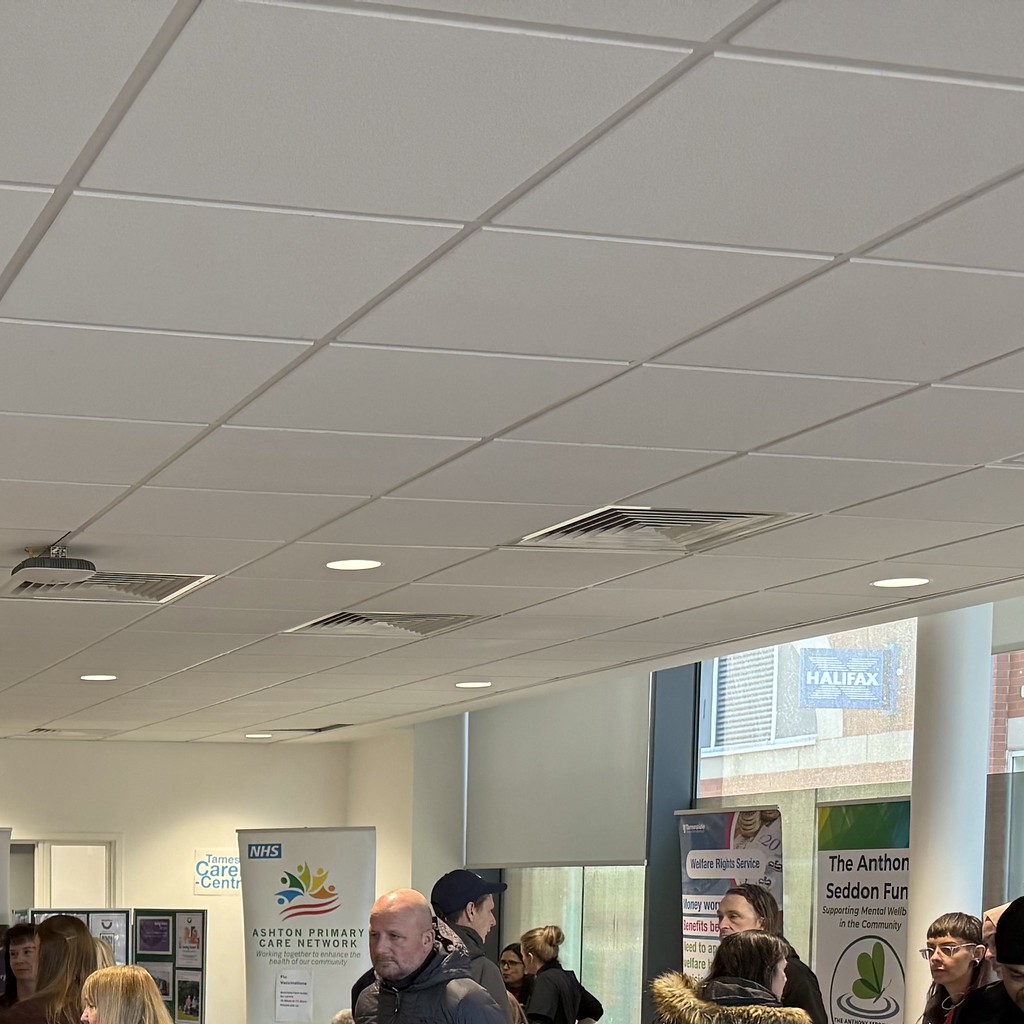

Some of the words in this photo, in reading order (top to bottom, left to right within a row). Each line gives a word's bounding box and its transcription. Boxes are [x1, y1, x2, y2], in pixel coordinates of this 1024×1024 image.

[806, 671, 879, 686] HALIFAX
[249, 844, 280, 858] NHS
[195, 860, 238, 877] Care
[690, 858, 714, 870] Welfare
[716, 858, 735, 871] Rights
[736, 857, 760, 869] Service
[829, 855, 853, 872] The
[857, 853, 909, 872] Anthon
[826, 882, 879, 899] Seddon
[883, 882, 908, 900] Fun
[822, 905, 859, 916] Supporting
[861, 906, 886, 916] Mental
[839, 919, 846, 928] in
[847, 919, 860, 929] the
[862, 920, 902, 931] Community
[252, 928, 302, 937] ASHTON
[308, 929, 365, 937] PRIMARY
[259, 939, 291, 948] CARE
[297, 939, 357, 948] NETWORK
[698, 942, 706, 954] to
[256, 950, 282, 958] Working
[283, 951, 311, 959] together
